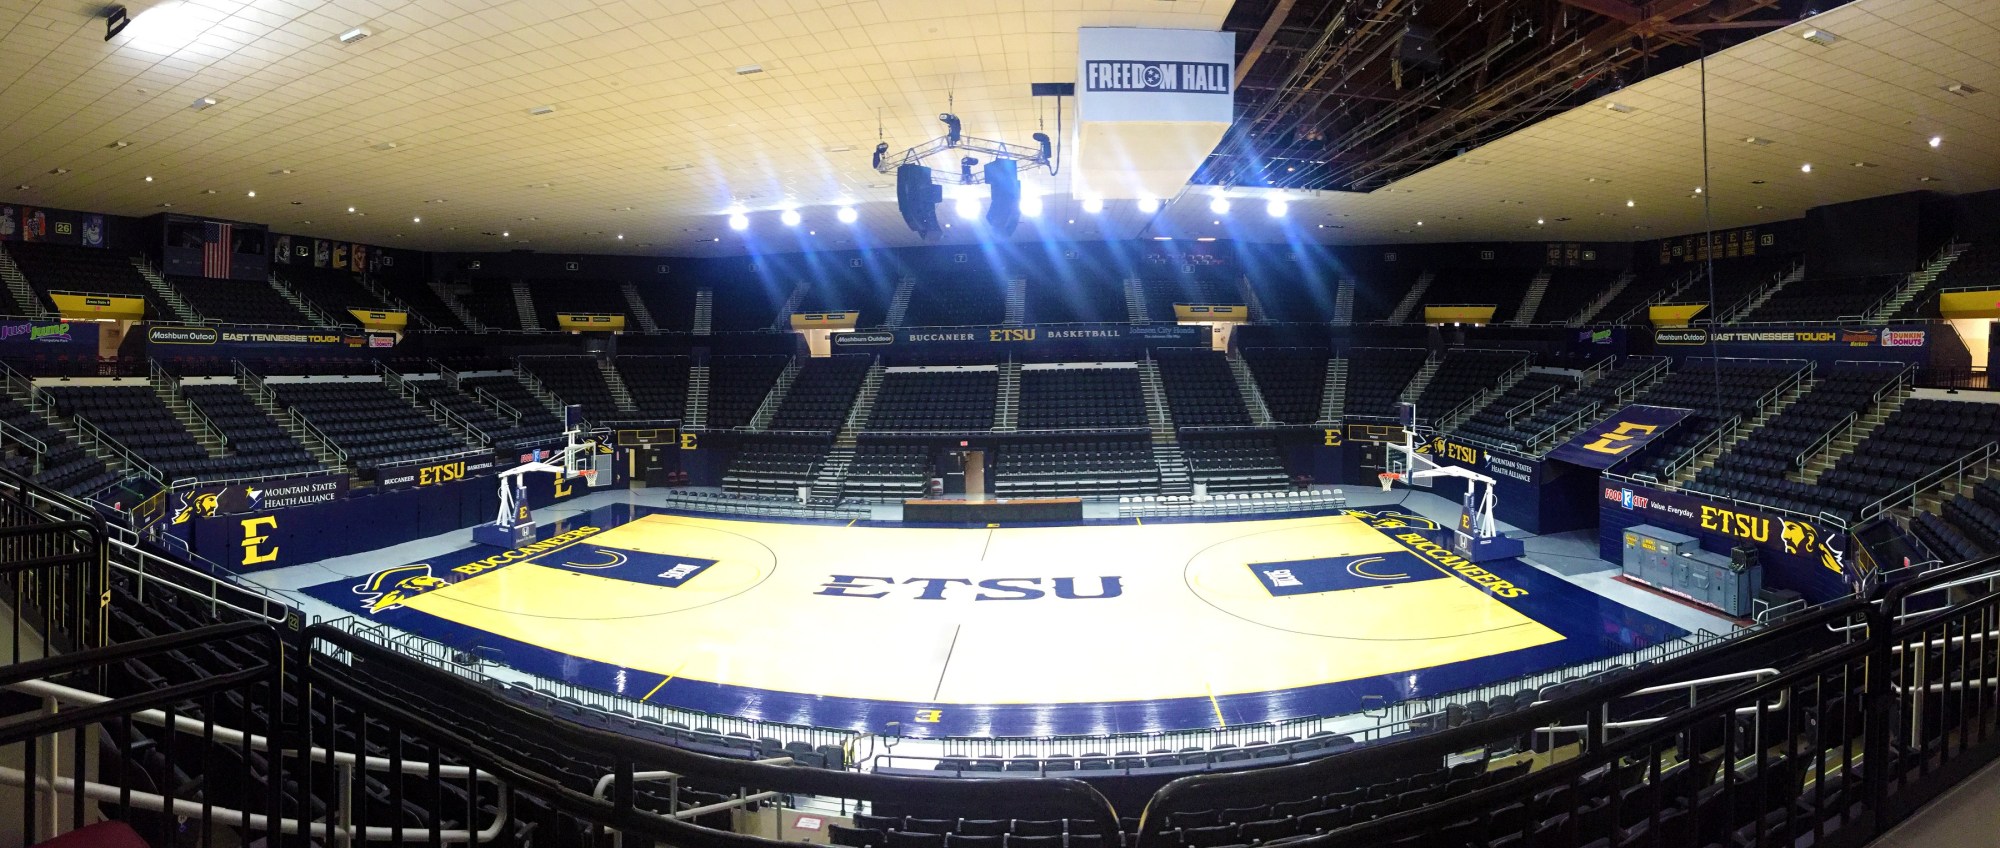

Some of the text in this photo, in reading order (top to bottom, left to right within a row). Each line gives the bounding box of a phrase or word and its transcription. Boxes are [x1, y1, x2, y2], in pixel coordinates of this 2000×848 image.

[1089, 63, 1227, 92] FREEDOM HALL
[57, 224, 70, 233] 26
[1, 323, 32, 340] Just
[151, 331, 215, 341] Mashburn Outdoor
[222, 332, 249, 341] EAST
[250, 333, 308, 342] TENNESSEE
[308, 335, 340, 343] TOUGH
[836, 335, 868, 343] Mashburn
[909, 329, 1121, 342] BUCCANEER ETSU BASKETBALL
[1129, 326, 1195, 335] Johnson City Honda
[1657, 333, 1705, 342] Mashburn Outdoor
[1711, 333, 1836, 341] EAST TENNESSEE TOUGH
[680, 433, 698, 450] E
[1324, 428, 1343, 446] E
[1583, 421, 1659, 455] E
[1448, 442, 1477, 465] ETSU
[384, 461, 493, 486] BUCCANEER ETSU BASKETBALL
[1491, 456, 1533, 474] MOUNTAIN STATES
[1491, 465, 1531, 483] HEALTH ALLIANCE
[264, 482, 337, 497] MOUNTAIN STATES
[264, 492, 336, 509] HEALTH ALLIANCE
[1604, 488, 1622, 503] FOOD
[1632, 495, 1649, 509] CITY
[1650, 501, 1666, 512] Value.
[1667, 505, 1695, 519] Everyday.
[519, 505, 528, 519] E
[1462, 514, 1471, 529] E
[1700, 504, 1770, 543] ETSU
[241, 515, 280, 566] E
[451, 525, 601, 575] BUCCANEERS
[1394, 532, 1530, 598] BUCCANEERS
[812, 574, 1124, 602] ETSU
